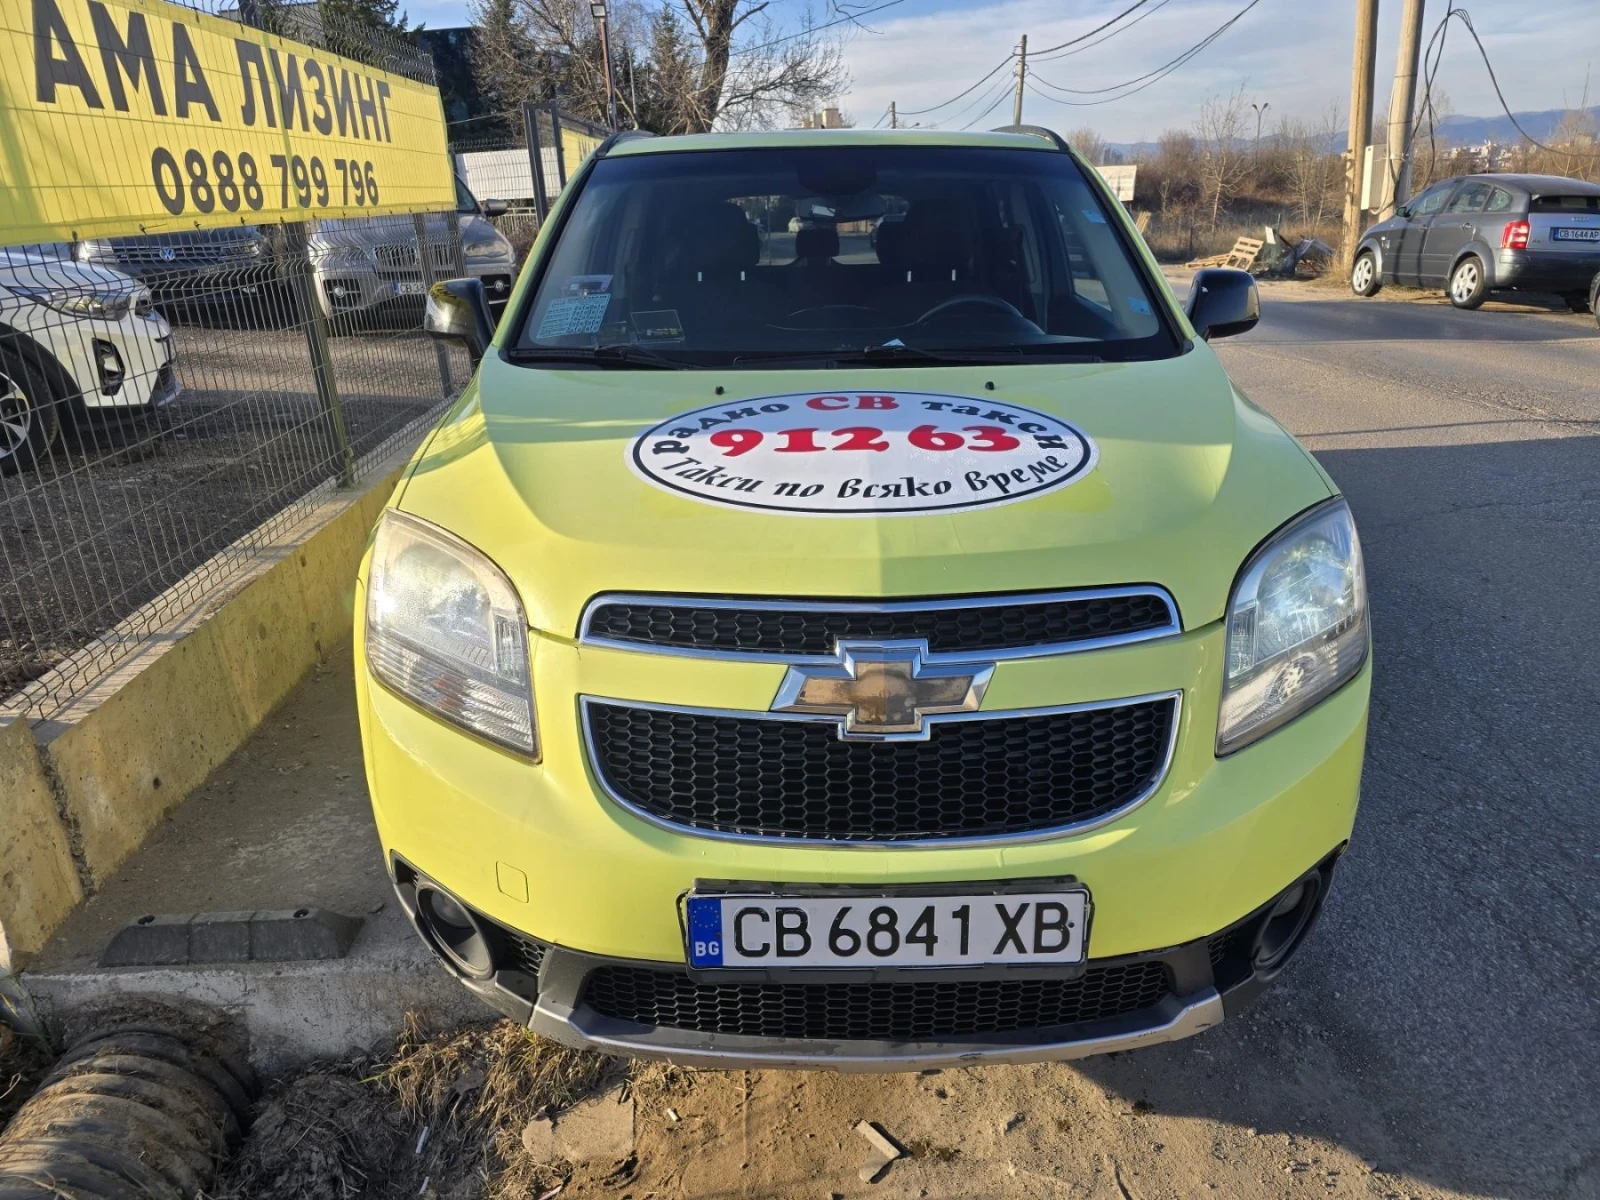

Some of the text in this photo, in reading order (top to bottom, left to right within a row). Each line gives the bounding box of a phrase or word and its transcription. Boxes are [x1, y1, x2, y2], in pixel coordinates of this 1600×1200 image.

[32, 0, 392, 144] АМА ЛИЗИНГ
[151, 146, 380, 216] 0888 799 796
[652, 395, 1068, 455] радио СВ такси
[709, 425, 1020, 457] 912 63
[661, 454, 1068, 499] Такси по всяко време
[694, 940, 720, 957] BG
[733, 902, 1070, 958] CB 6841 XB
